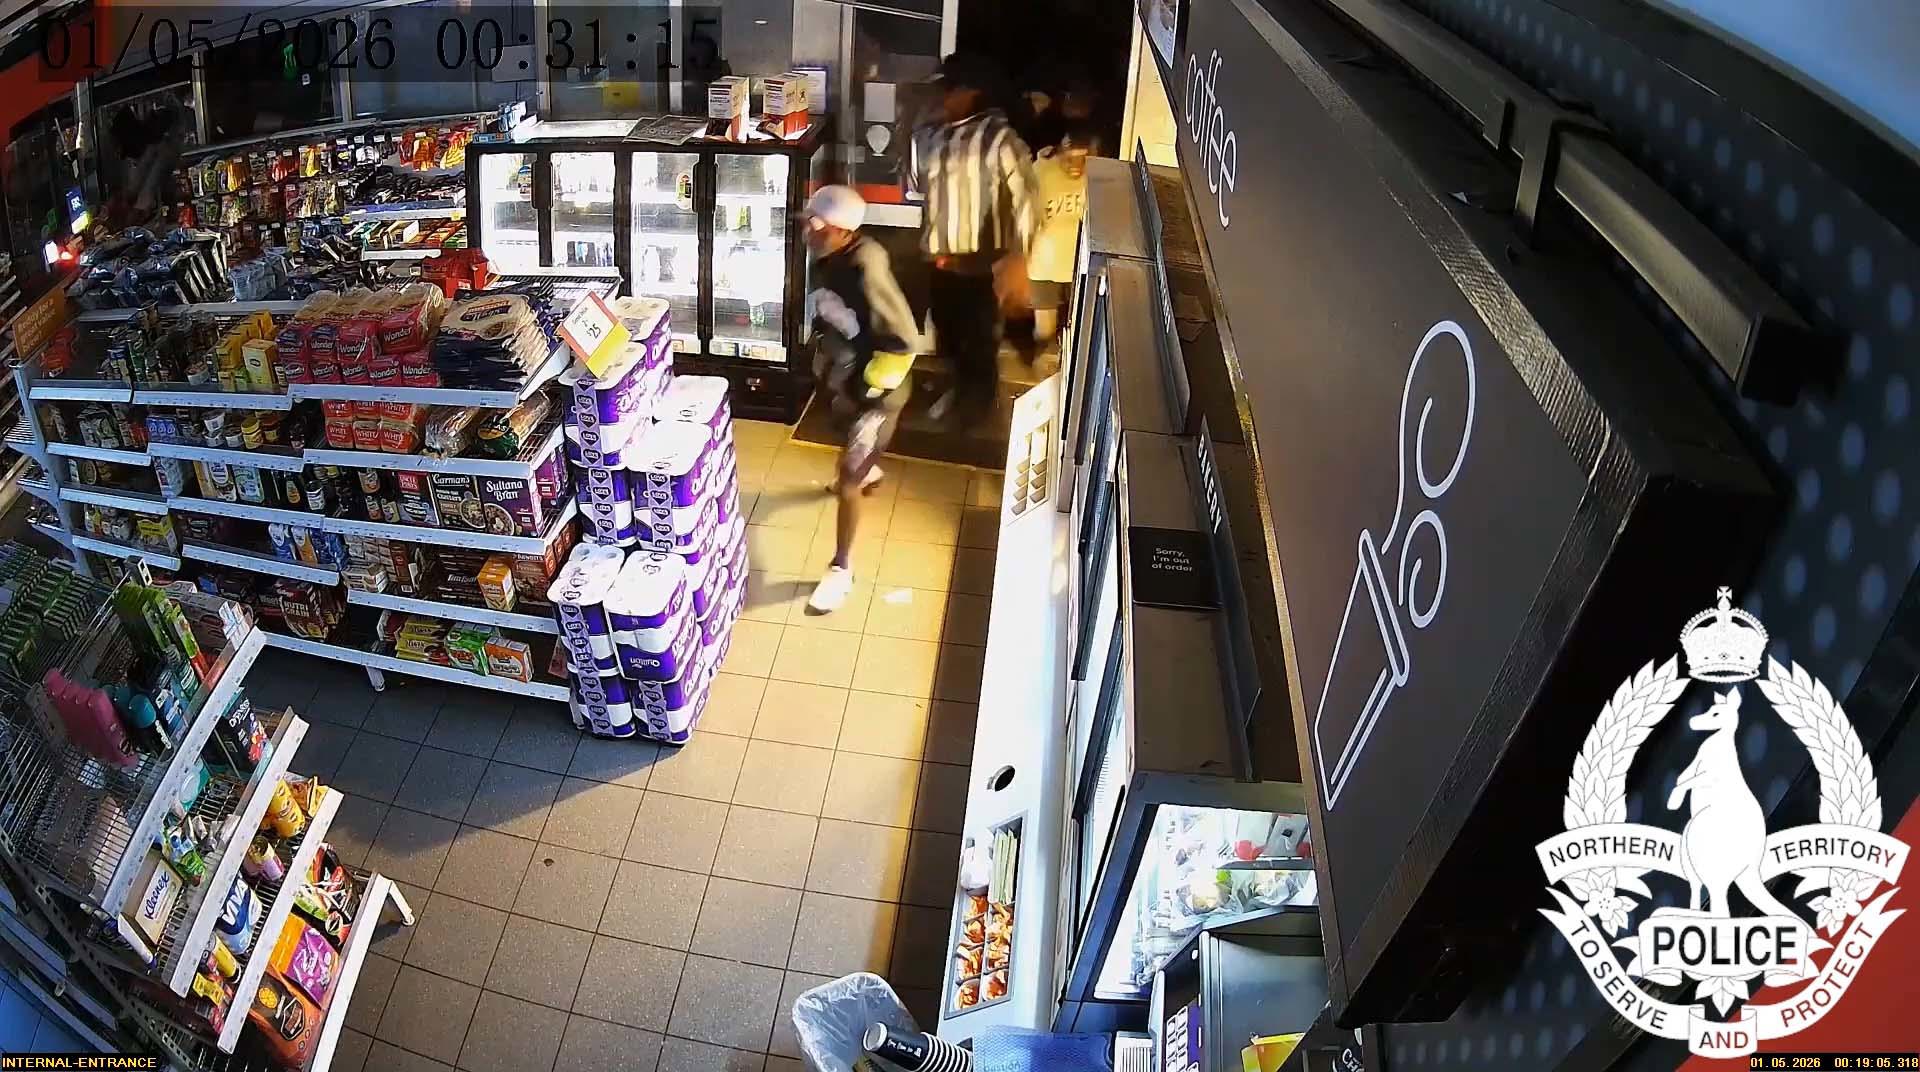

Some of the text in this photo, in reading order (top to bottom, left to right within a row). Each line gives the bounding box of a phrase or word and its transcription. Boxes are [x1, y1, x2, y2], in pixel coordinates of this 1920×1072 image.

[1185, 48, 1239, 231] coffee
[383, 327, 412, 342] Wonder
[403, 365, 432, 375] Wonder
[432, 474, 470, 484] Carman's
[1198, 433, 1222, 534] BAKERY
[486, 480, 523, 493] Sultana
[495, 489, 518, 501] Bran
[1155, 547, 1185, 557] Sorry,
[1153, 555, 1170, 563] I'm
[1164, 563, 1193, 572] order
[144, 872, 170, 920] Kleenex
[221, 878, 250, 926] VIVA
